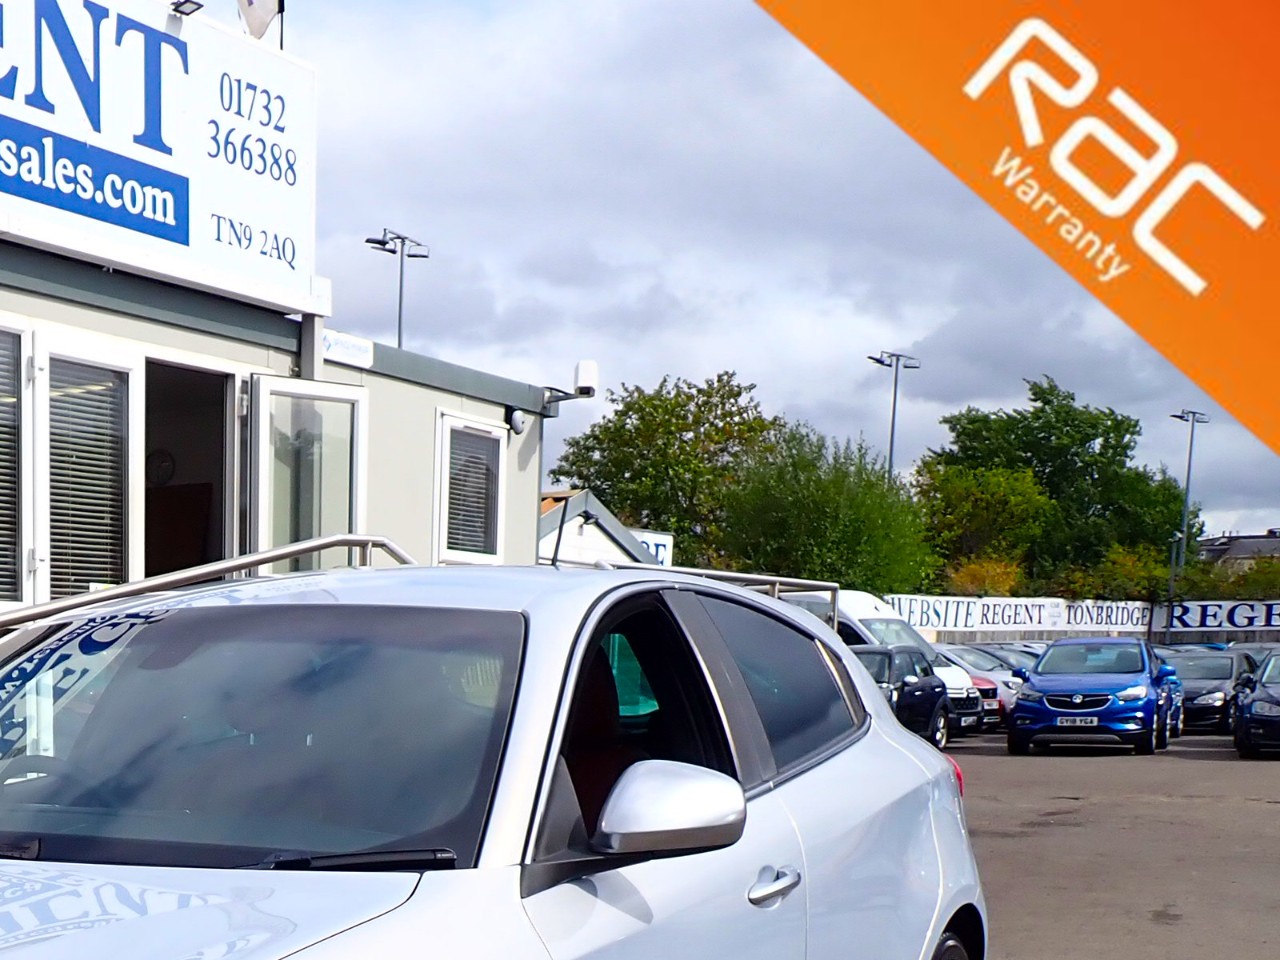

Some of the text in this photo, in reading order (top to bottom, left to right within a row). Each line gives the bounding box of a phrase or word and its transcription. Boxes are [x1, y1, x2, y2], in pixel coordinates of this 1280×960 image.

[219, 72, 286, 133] 01732
[207, 119, 297, 186] 366388
[210, 213, 296, 270] TN9 2AQ
[980, 603, 1045, 625] REGENT
[1065, 604, 1151, 626] TONBRIDGE
